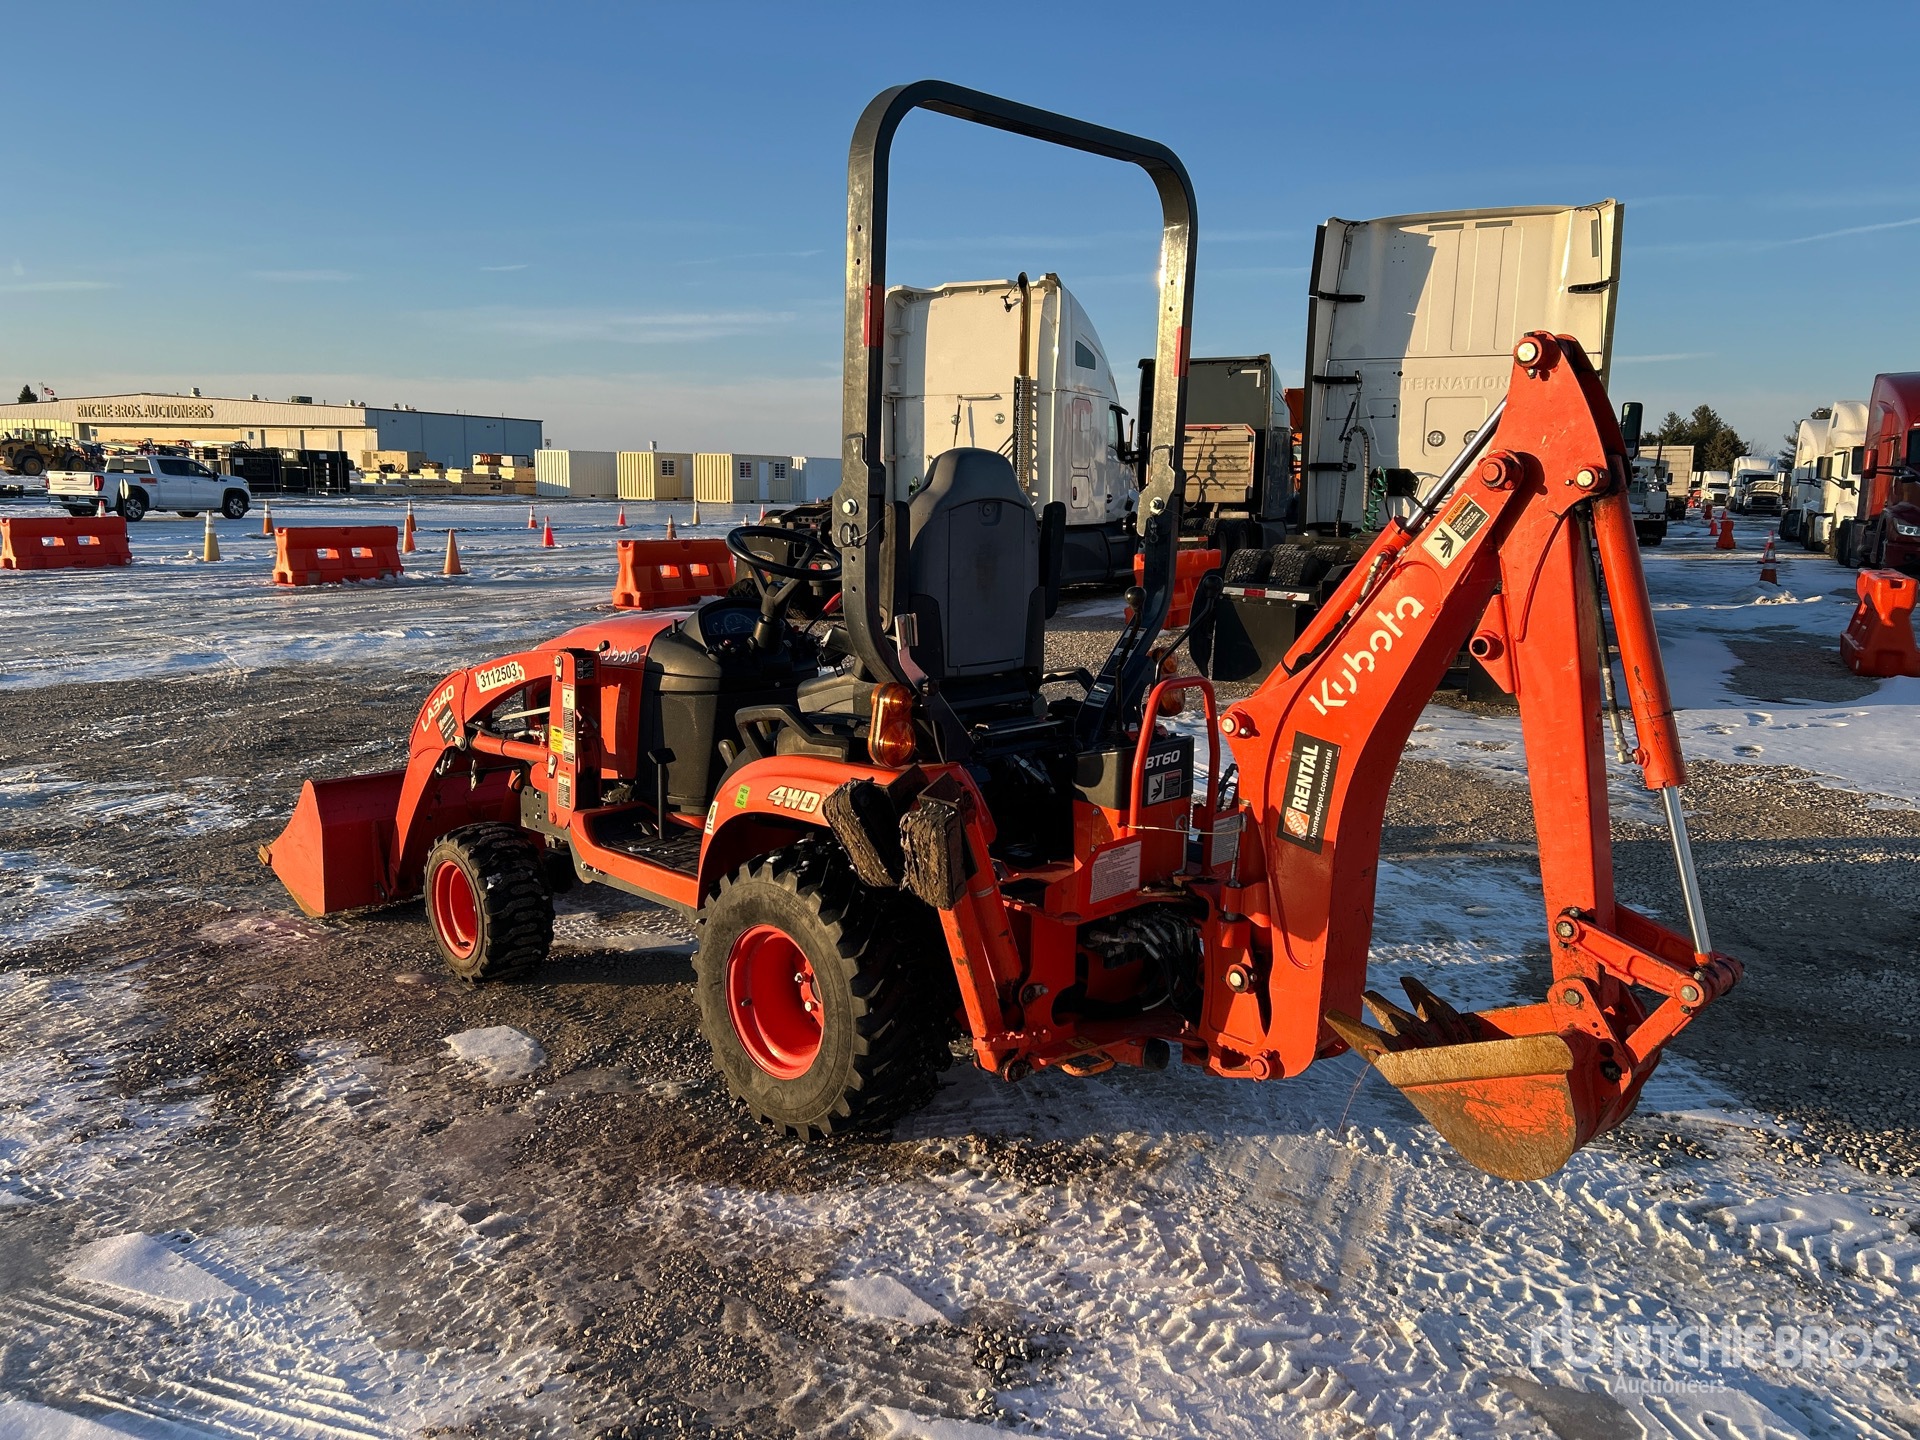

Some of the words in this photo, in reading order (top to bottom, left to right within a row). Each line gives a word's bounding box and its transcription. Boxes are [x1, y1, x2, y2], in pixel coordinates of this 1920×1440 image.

[1402, 375, 1510, 391] TERNATION
[77, 404, 113, 418] RITCHIE
[115, 404, 143, 418] BROS.
[143, 404, 214, 418] AUCTIONEERS
[1309, 596, 1424, 716] Kubota
[480, 663, 518, 689] 3112503
[421, 684, 455, 733] LA340
[1144, 750, 1181, 770] BT60
[1291, 744, 1319, 812] RENTAL
[766, 785, 821, 813] 4WD
[1310, 749, 1333, 839] homedepot.com/rental
